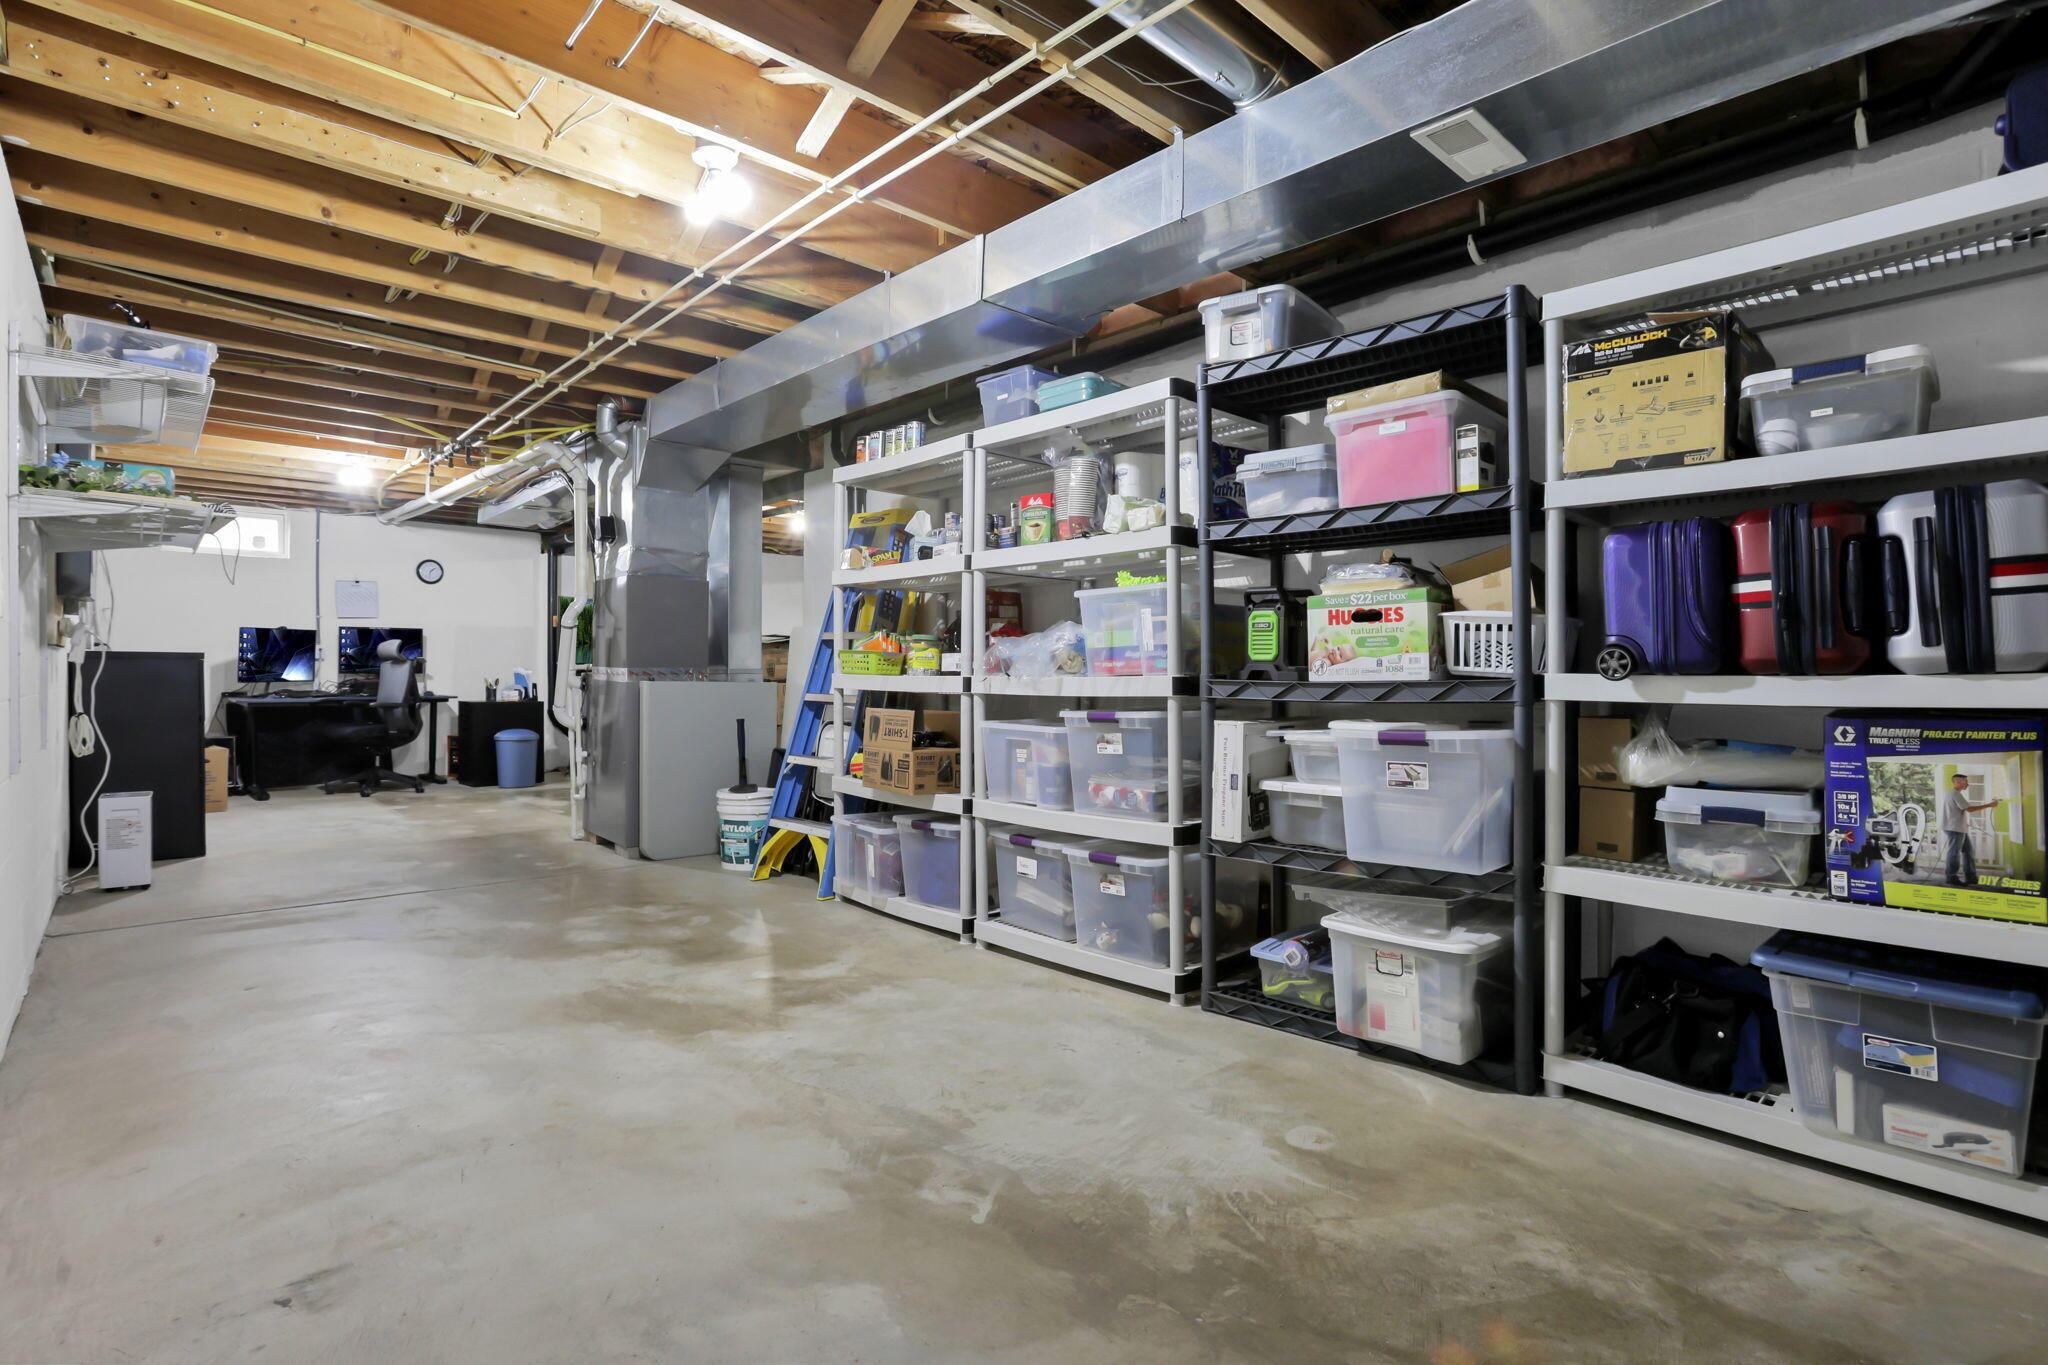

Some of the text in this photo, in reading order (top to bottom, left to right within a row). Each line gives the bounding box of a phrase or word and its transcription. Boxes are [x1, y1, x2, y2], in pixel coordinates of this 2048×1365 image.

[871, 551, 892, 564] SPAM
[1324, 590, 1408, 606] Save $22 per box
[1327, 606, 1404, 625] HUIES
[1350, 625, 1405, 636] natural care
[1868, 726, 1921, 738] MAGNUM
[1922, 730, 1963, 740] PROJECT
[2010, 731, 2038, 740] PLUS
[1978, 875, 2041, 891] DIY SERIES
